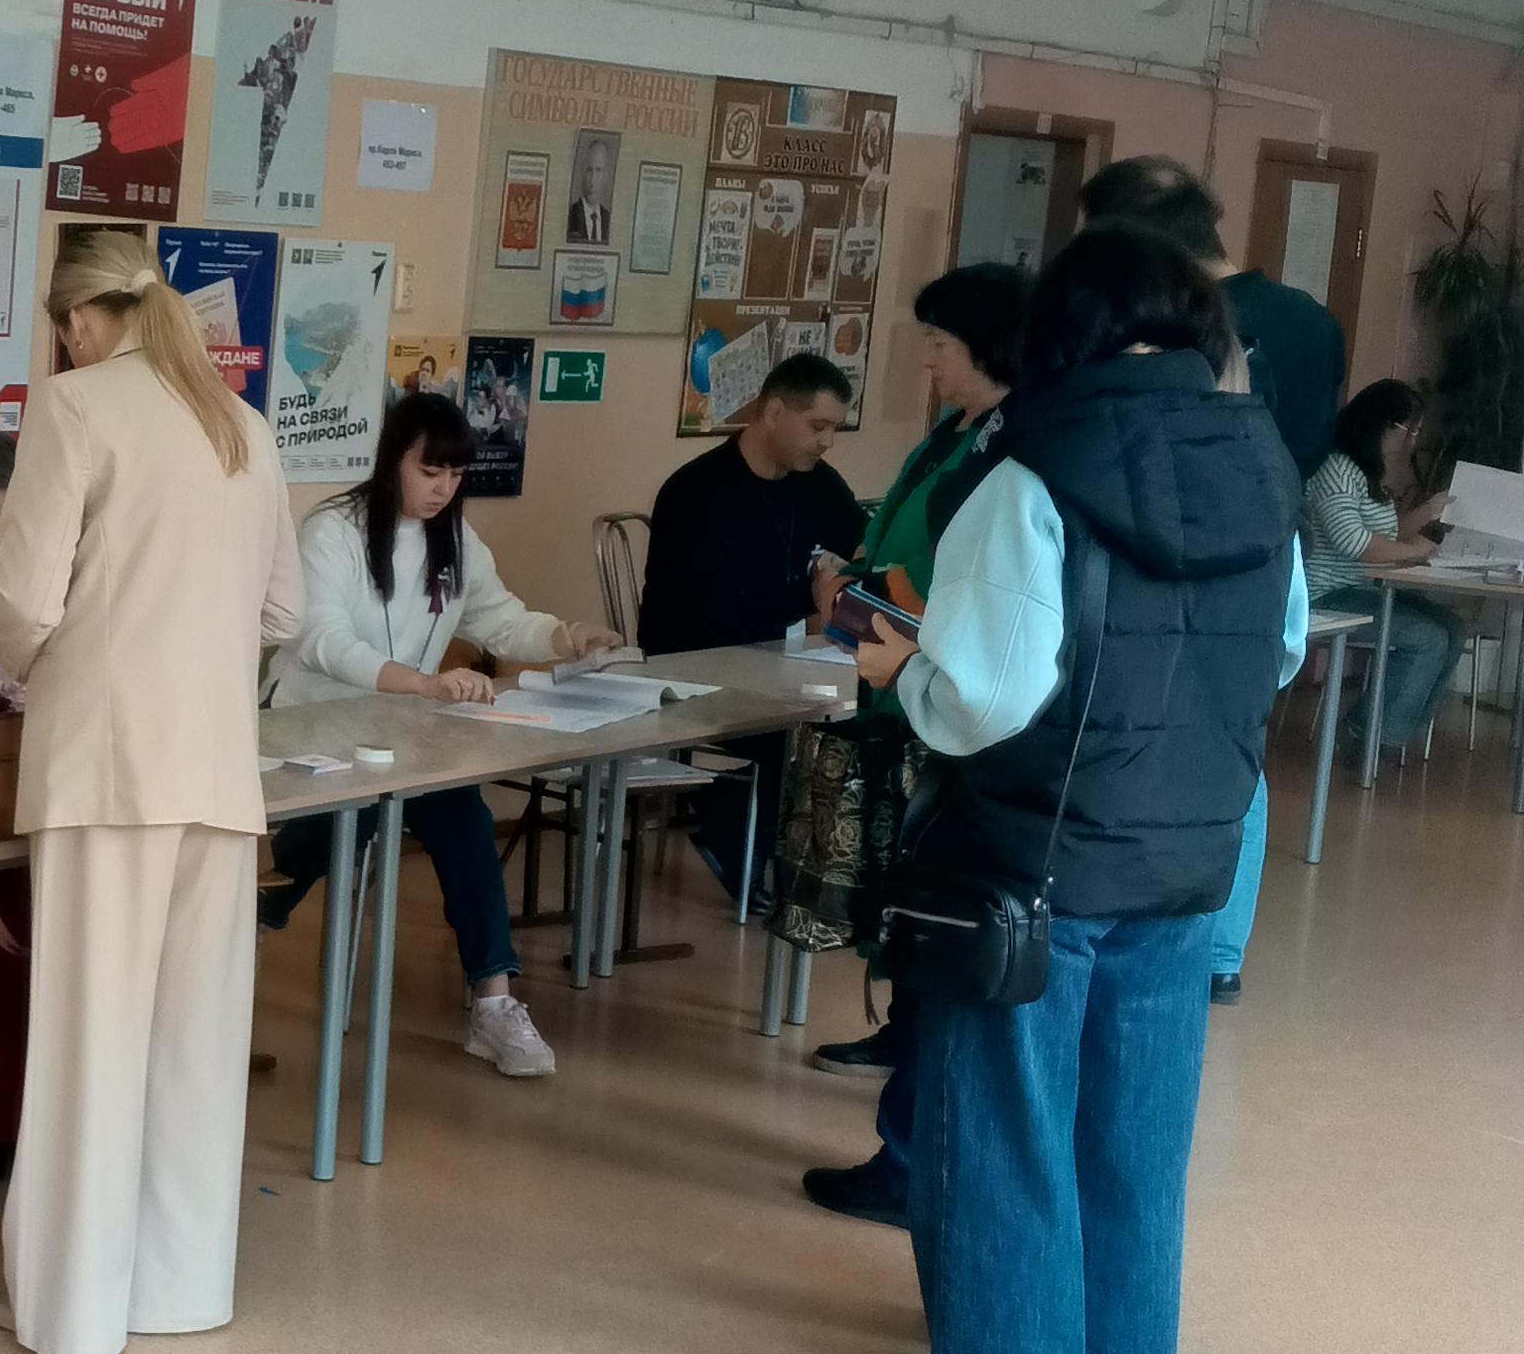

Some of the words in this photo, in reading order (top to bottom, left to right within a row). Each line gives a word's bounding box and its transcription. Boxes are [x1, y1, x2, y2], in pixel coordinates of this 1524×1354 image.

[73, 3, 117, 21] ВСЕГДА
[119, 9, 165, 29] ПРИДЕТ
[71, 18, 87, 31] НА
[90, 21, 148, 41] ПОМОЩЬ!
[502, 55, 699, 106] ГОСУДАРСТВЕННЫЕ
[508, 90, 608, 127] СИМВОЛЫ
[625, 103, 700, 138] РОССИИ
[783, 136, 827, 152] КЛАСС
[764, 155, 789, 168] ЭТО
[793, 156, 818, 171] ПРО
[821, 160, 845, 174] НАС
[209, 350, 261, 366] ЖДАНЕ
[279, 394, 317, 411] БУДЬ
[276, 415, 298, 430] НА
[299, 406, 348, 425] СВЯЗИ
[276, 435, 286, 448] С
[288, 418, 368, 447] ПРИРОДОЙ
